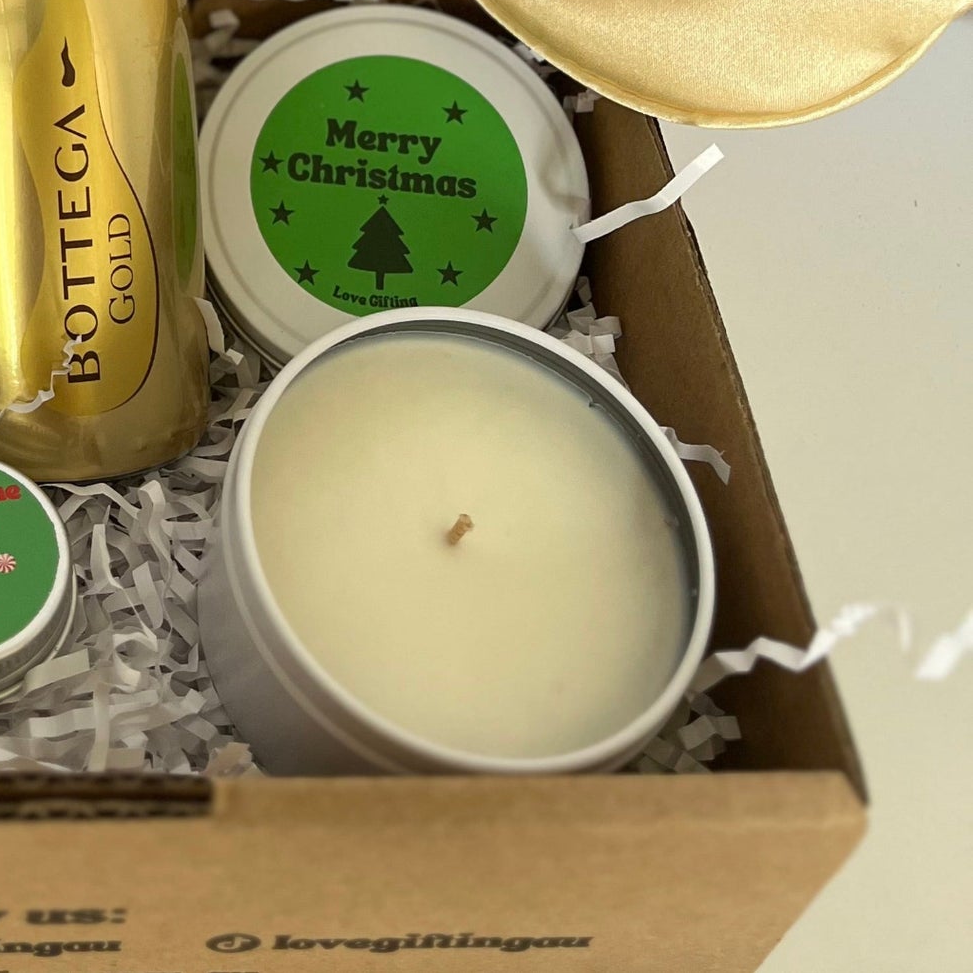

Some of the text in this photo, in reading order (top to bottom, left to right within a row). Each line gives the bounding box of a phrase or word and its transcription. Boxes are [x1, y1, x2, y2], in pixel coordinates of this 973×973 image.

[325, 118, 442, 165] Merry
[286, 152, 478, 199] Christmas
[53, 103, 102, 384] BOTTEGA
[107, 212, 136, 325] GOLD
[332, 285, 419, 307] Love Gifting
[24, 907, 126, 925] us:
[271, 931, 595, 954] lovegiftingau
